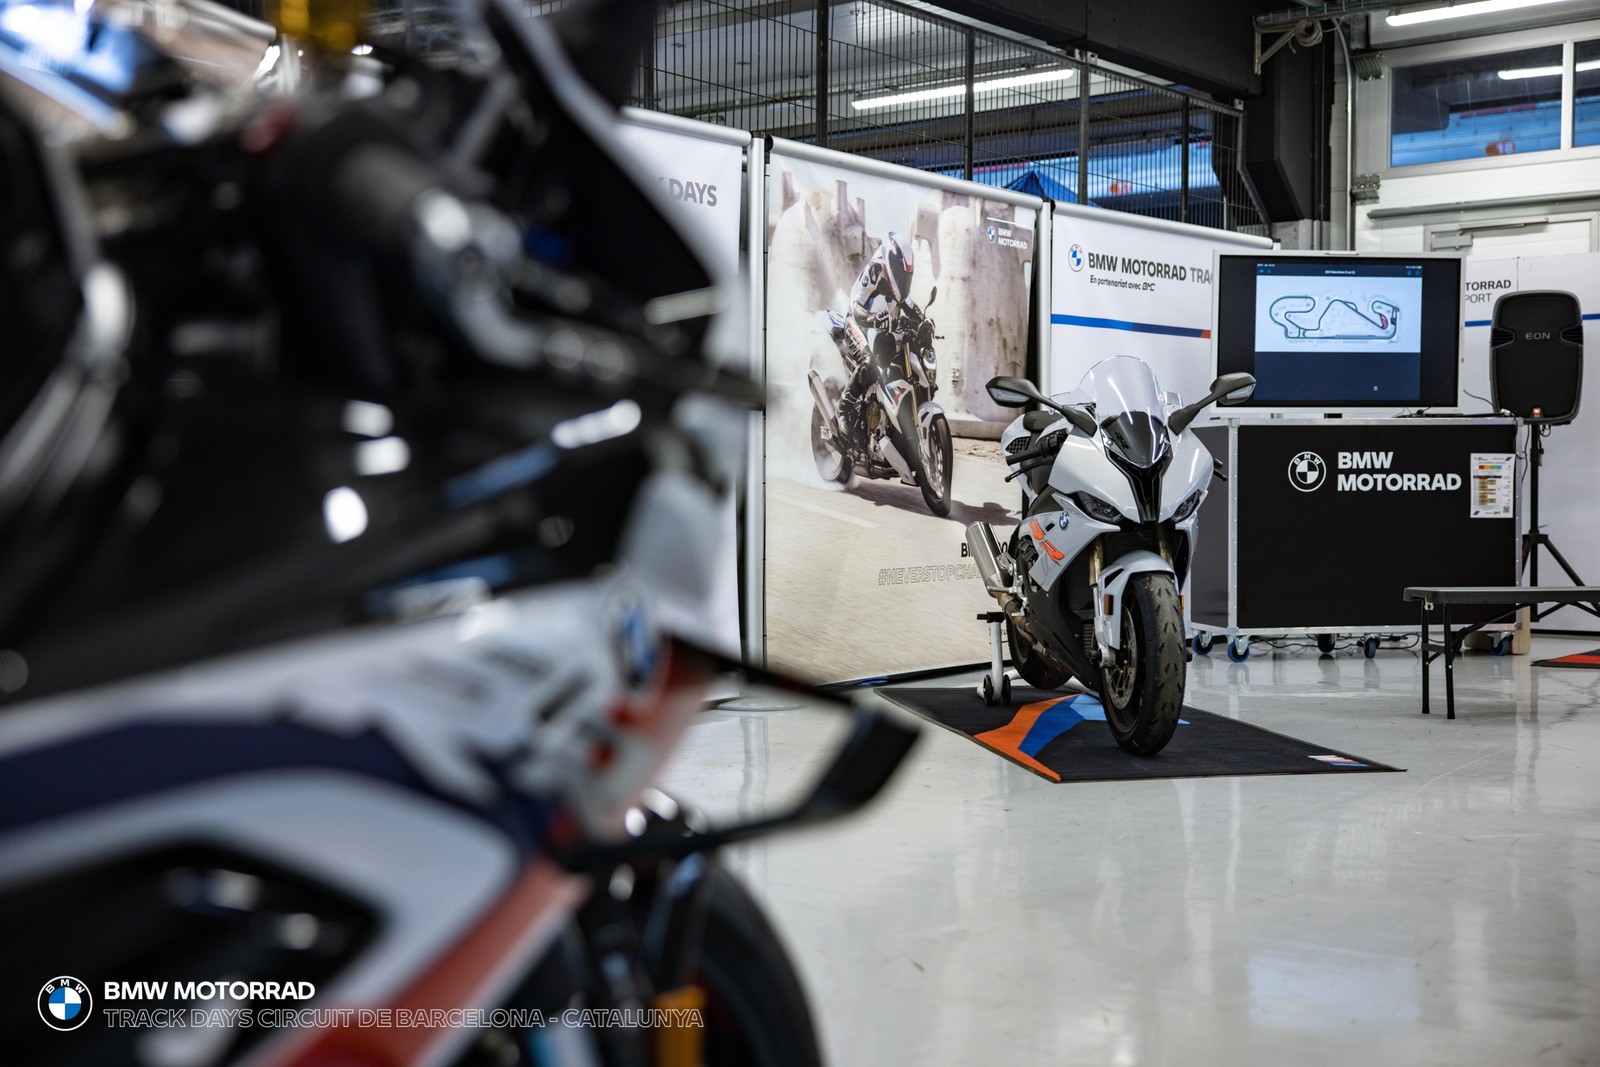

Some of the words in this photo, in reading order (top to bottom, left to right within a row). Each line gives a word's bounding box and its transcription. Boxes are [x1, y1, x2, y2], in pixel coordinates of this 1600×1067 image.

[669, 178, 718, 207] DAYS
[998, 227, 1012, 238] BMW
[998, 237, 1028, 250] MOTORRAD
[1088, 252, 1118, 272] BMW
[1121, 257, 1187, 281] MOTORRAD
[1190, 267, 1213, 285] TRA
[1090, 274, 1097, 284] En
[1097, 278, 1128, 289] partenariat
[1128, 282, 1141, 290] avec
[1525, 332, 1551, 340] EON
[1337, 451, 1394, 469] BMW
[1337, 473, 1462, 491] MOTORRAD
